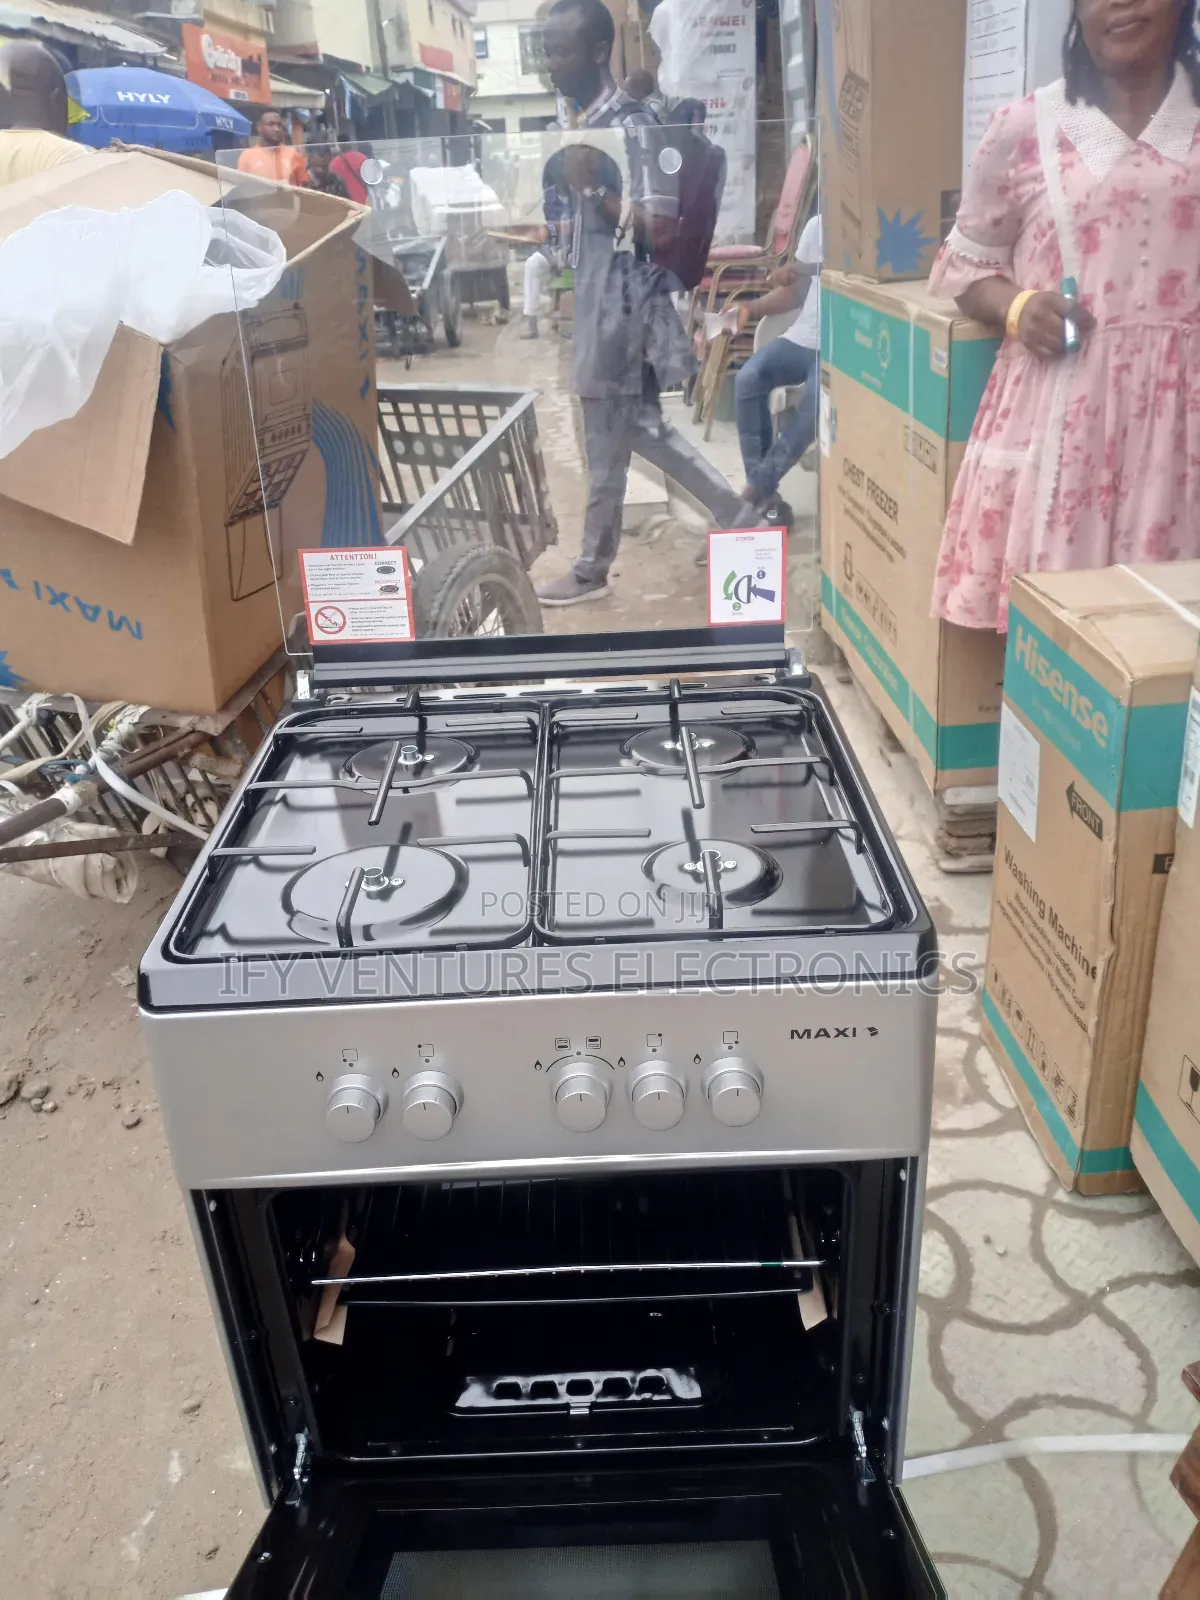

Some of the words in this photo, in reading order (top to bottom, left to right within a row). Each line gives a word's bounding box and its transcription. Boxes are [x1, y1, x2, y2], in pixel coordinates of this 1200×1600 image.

[116, 91, 171, 104] HYLY
[214, 115, 234, 129] HYLY
[866, 476, 899, 526] FREEZER
[329, 553, 377, 561] ATTENTION!
[33, 580, 143, 640] MAXI
[1015, 624, 1108, 748] Hisense
[1072, 791, 1101, 833] FRONT
[1004, 844, 1046, 920] Washing
[1048, 905, 1098, 980] Machine
[790, 1026, 857, 1040] MAXI
